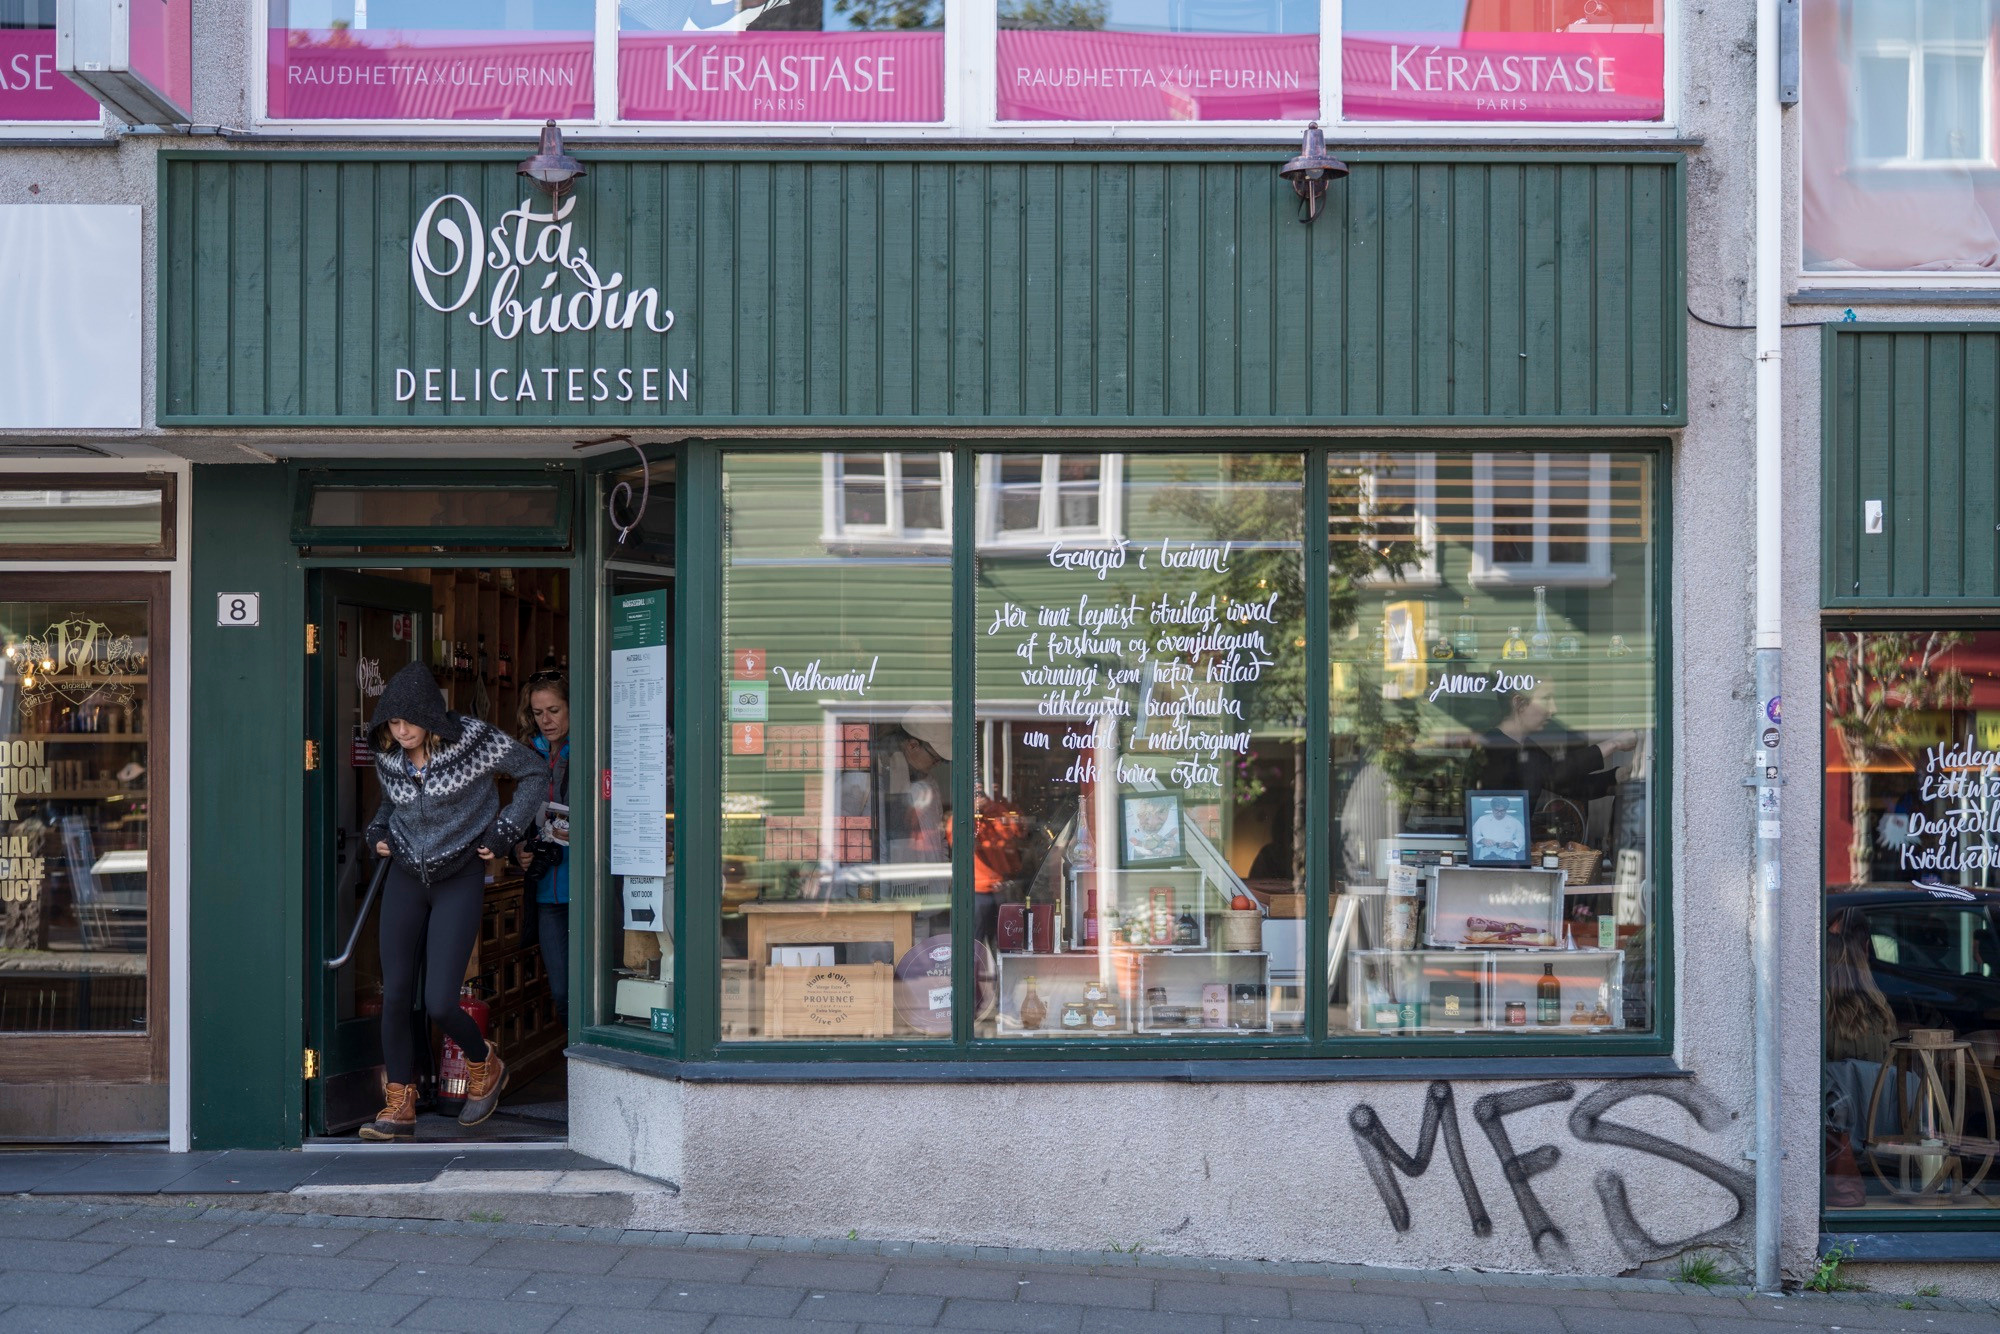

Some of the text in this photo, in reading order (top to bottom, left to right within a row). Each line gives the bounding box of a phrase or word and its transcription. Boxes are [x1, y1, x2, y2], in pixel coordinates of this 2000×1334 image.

[288, 61, 574, 86] RAUÐHETTA ÚLFURINN
[666, 44, 895, 92] KÉRASTASE
[1017, 64, 1300, 89] RAUÐHETTA ÚLFURINN
[1390, 44, 1616, 92] KÉRASTASE
[753, 98, 806, 111] PARIS
[1476, 98, 1528, 111] PARIS
[395, 367, 689, 402] DELICATESSEN
[1047, 534, 1130, 580] Gangið
[229, 598, 247, 621] 8
[1038, 604, 1071, 627] inni
[1078, 593, 1145, 635] leynist
[1150, 591, 1219, 631] ótrúlegt
[1226, 592, 1279, 624] úrval
[1016, 622, 1272, 664] af ferskum og óvenjulegum
[772, 655, 879, 696] Velkomin!
[1020, 651, 1275, 696] varningi sem hefur kitlað
[1493, 669, 1535, 693] 2000
[1144, 685, 1245, 727] bragðlauka
[1023, 730, 1050, 750] um
[1062, 725, 1117, 751] árabil
[1148, 724, 1253, 760] miðborginni
[1116, 756, 1158, 784] bara
[1170, 753, 1223, 789] ostar
[0, 836, 32, 858] IAL
[0, 879, 41, 902] UCT
[630, 876, 655, 885] RESTAURANT
[631, 890, 653, 898] NEXT DOOR
[803, 995, 855, 1003] PROVENCE
[1348, 1079, 1756, 1270] MFS
